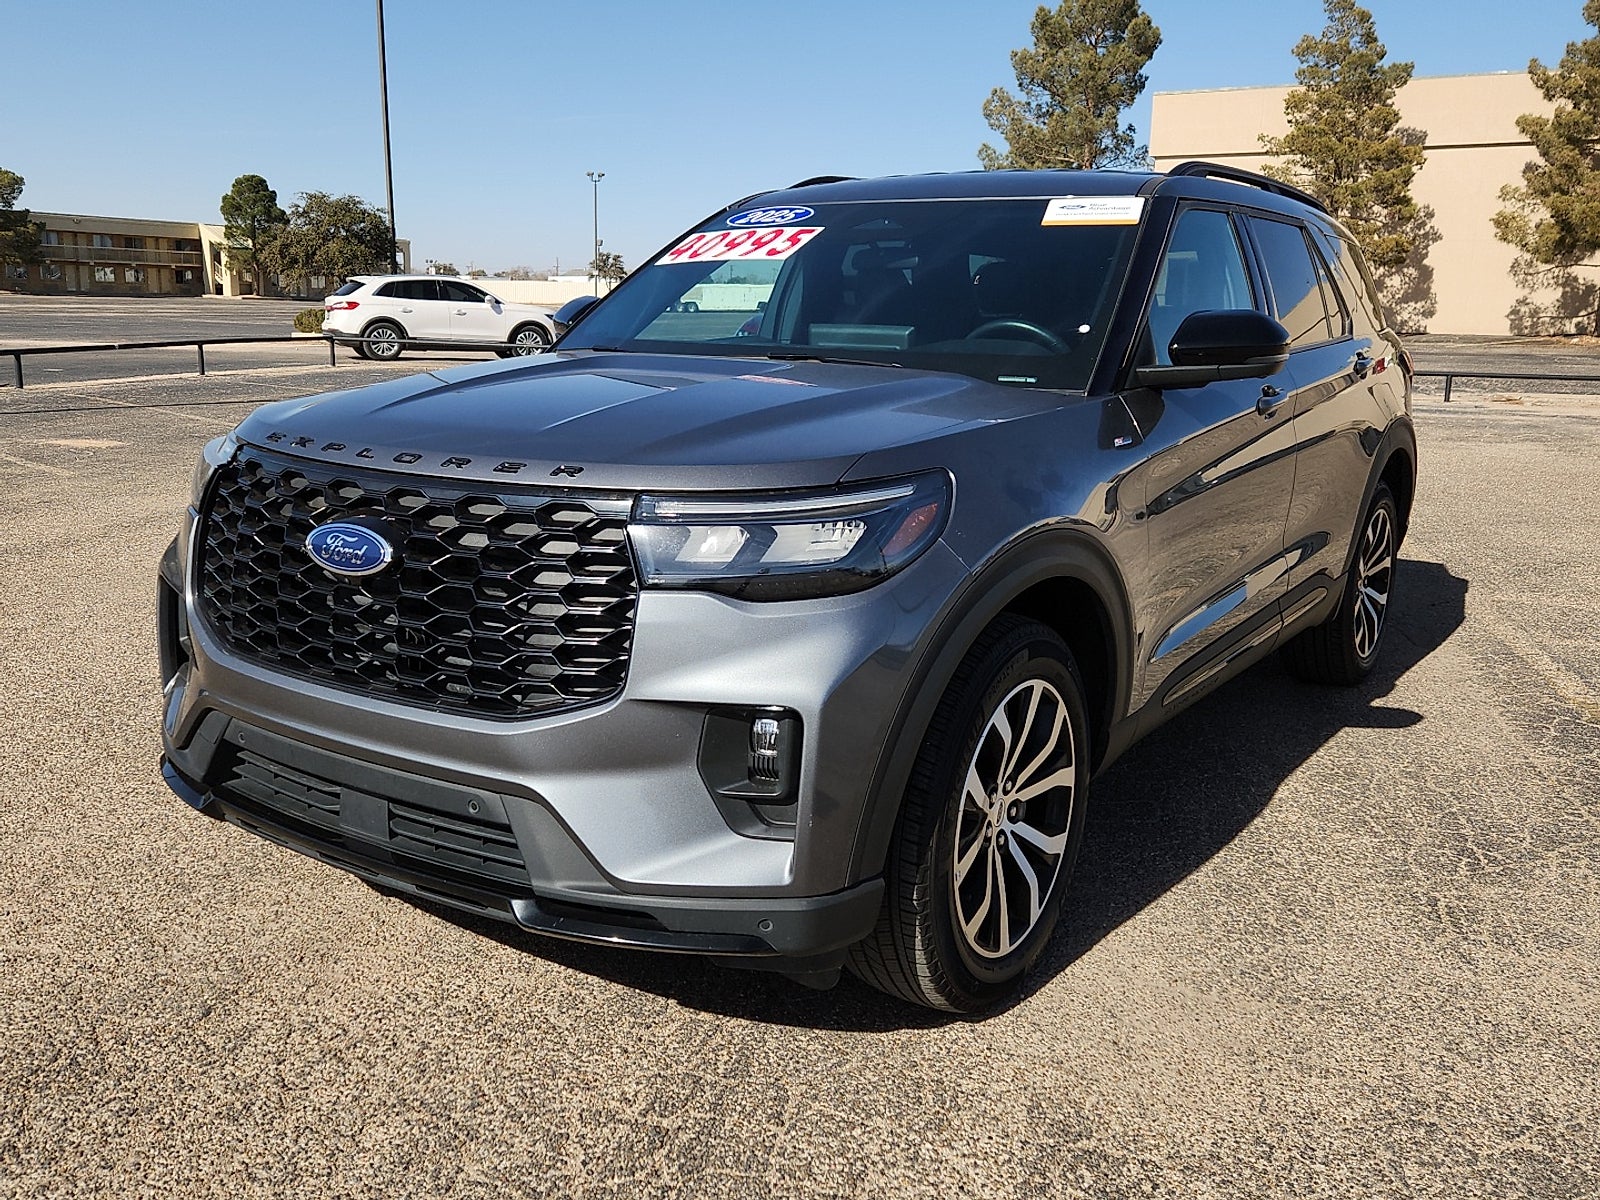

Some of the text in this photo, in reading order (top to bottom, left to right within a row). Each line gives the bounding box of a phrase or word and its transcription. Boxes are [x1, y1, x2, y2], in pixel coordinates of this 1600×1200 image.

[735, 209, 806, 224] 2025
[668, 229, 818, 261] 40995
[265, 431, 585, 478] EXPLORER
[321, 532, 368, 565] Ford
